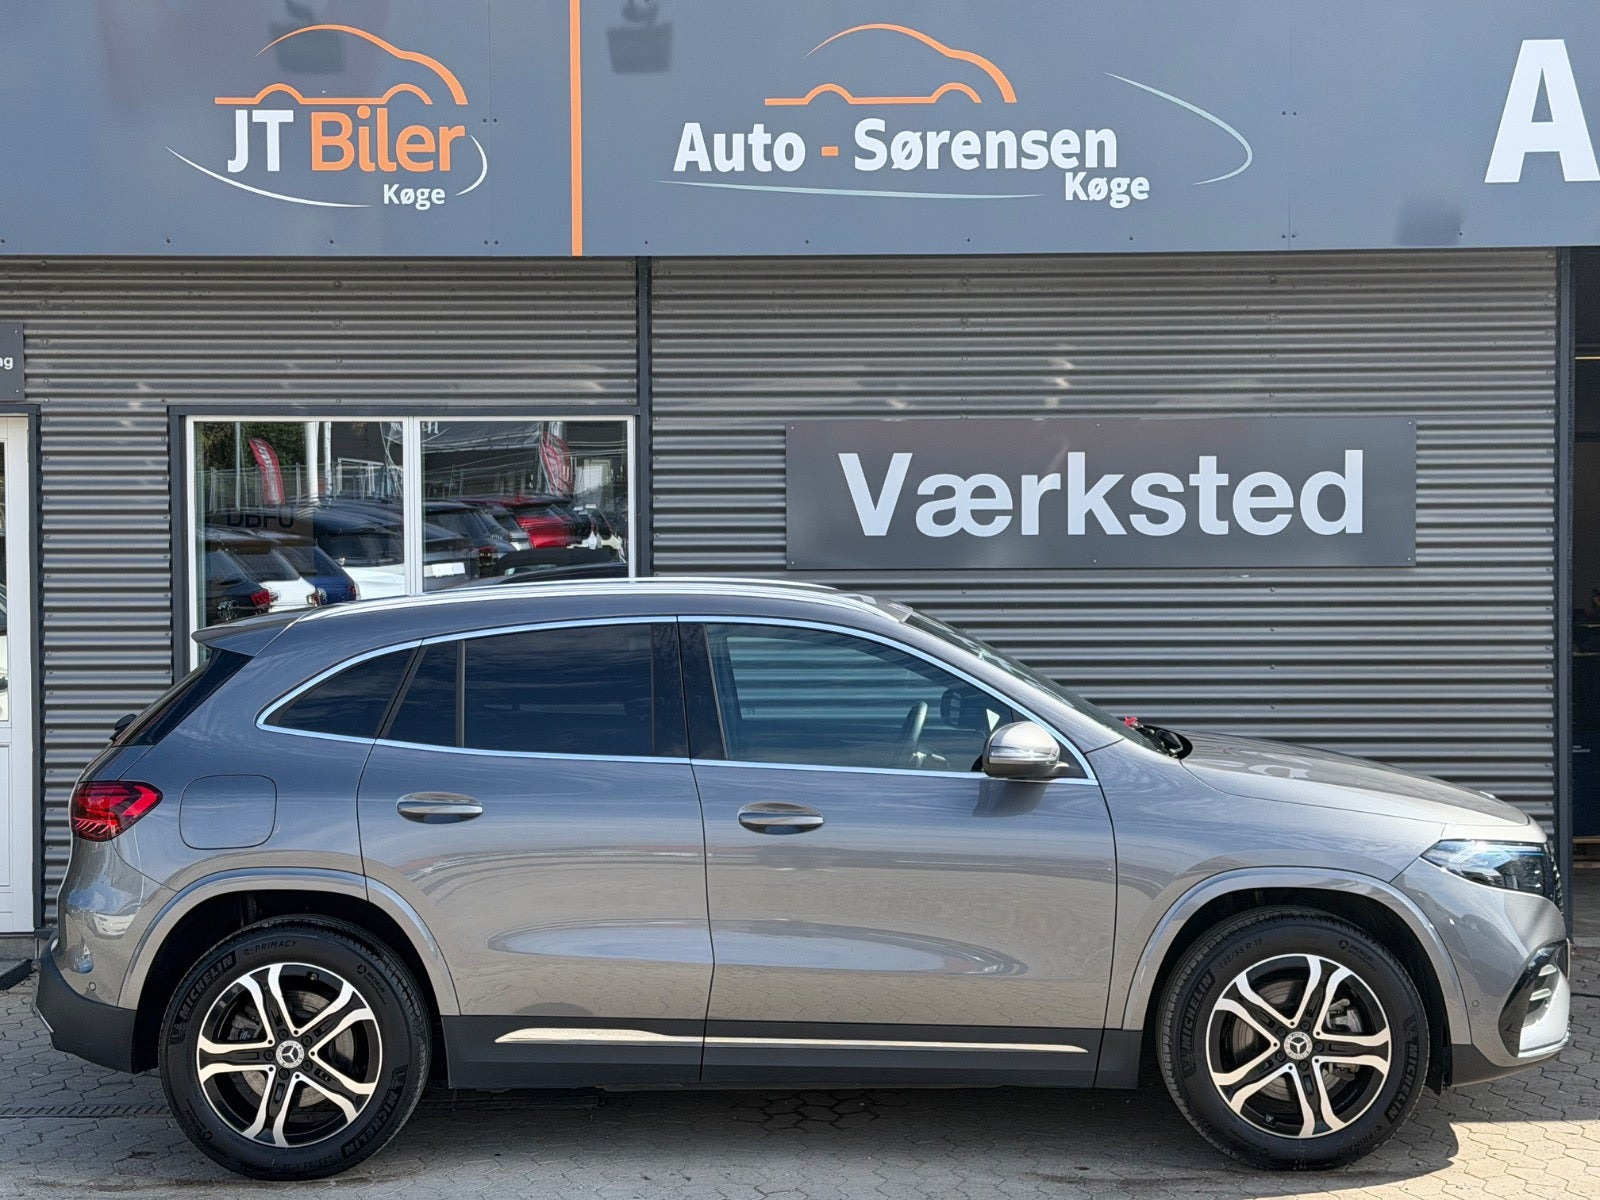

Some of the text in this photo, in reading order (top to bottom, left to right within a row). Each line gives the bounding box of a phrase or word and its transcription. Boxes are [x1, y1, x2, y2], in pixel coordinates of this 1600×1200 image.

[227, 105, 465, 173] JT Biler
[1484, 39, 1600, 183] A
[673, 122, 806, 173] Auto
[854, 118, 1118, 171] Sørensen
[382, 182, 446, 211] Køge
[1064, 171, 1151, 209] Køge
[838, 449, 1364, 537] Værksted
[180, 953, 234, 1019] MICHELIN
[1181, 971, 1213, 1052] MICHELIN
[1387, 1042, 1419, 1121] MICHELIN
[343, 1089, 401, 1158] MICHELIN
